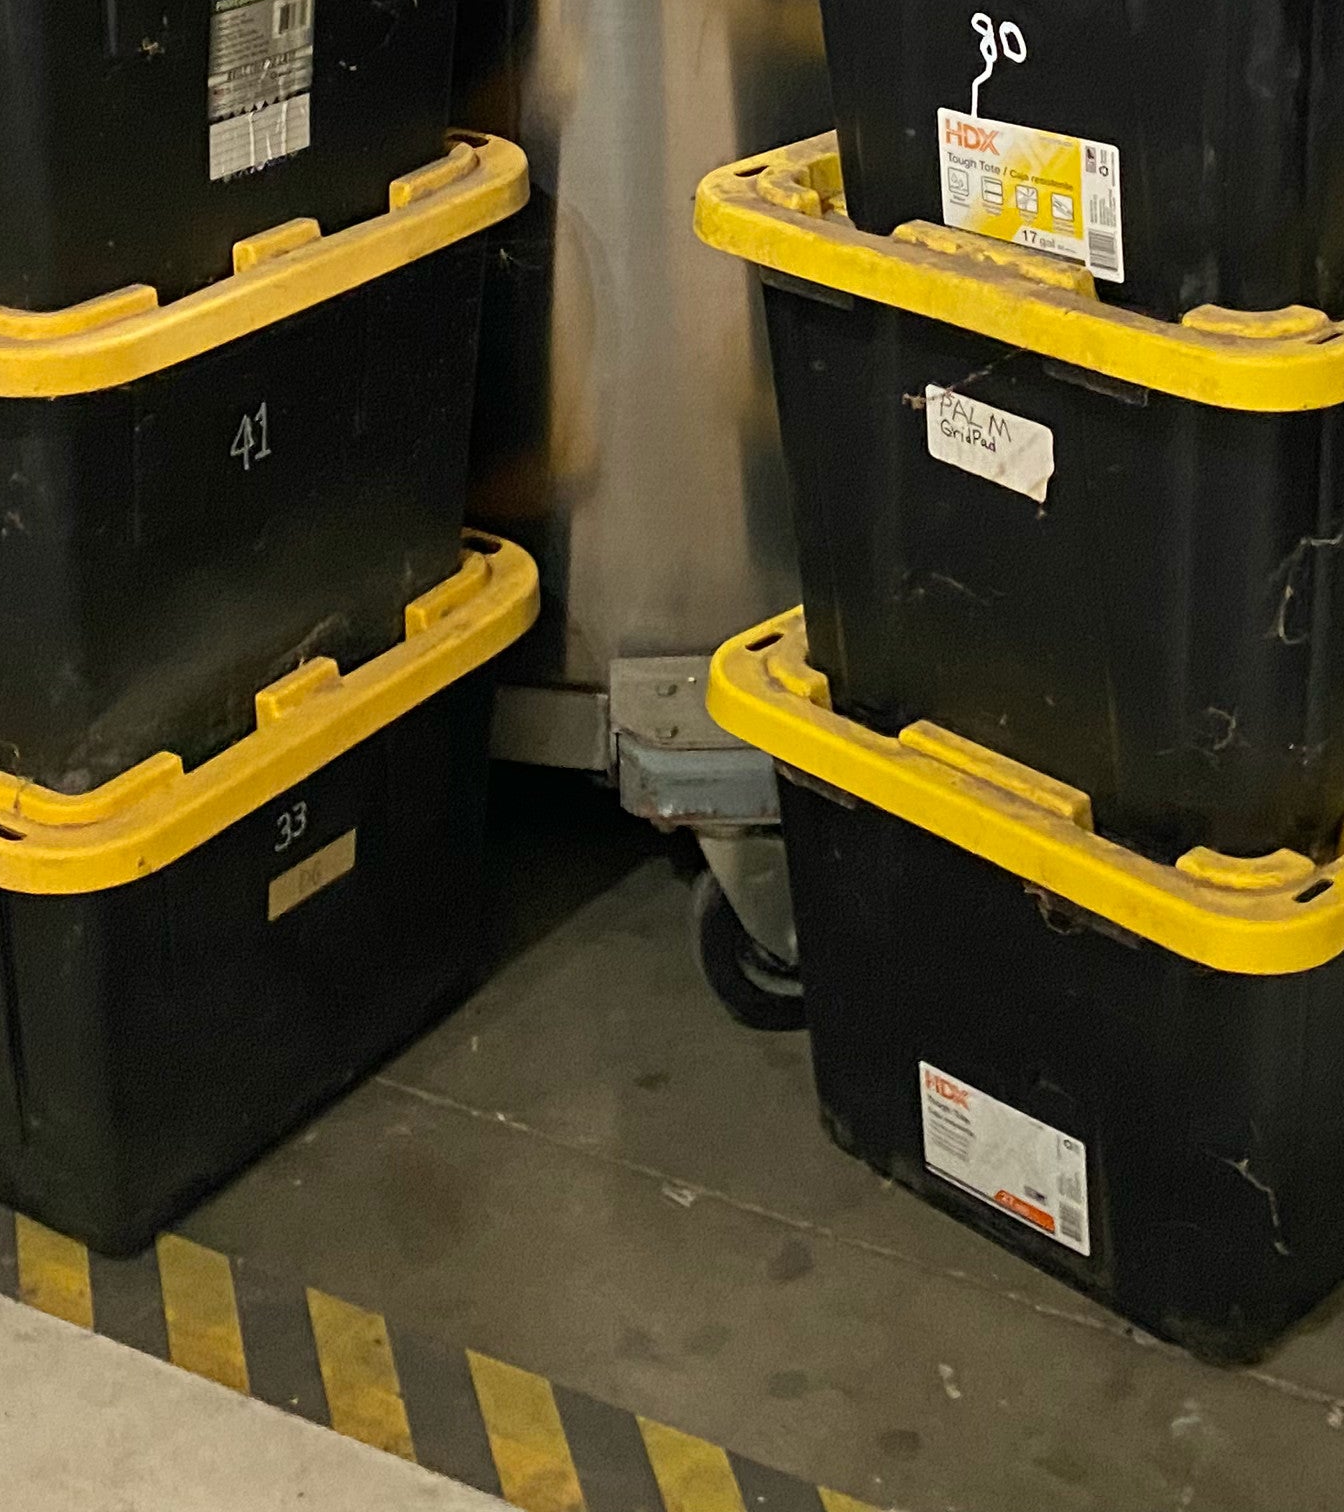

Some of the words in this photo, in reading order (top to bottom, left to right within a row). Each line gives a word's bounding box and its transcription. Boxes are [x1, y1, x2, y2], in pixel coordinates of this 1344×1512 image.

[971, 12, 1028, 72] 80
[945, 118, 1000, 156] HDX
[947, 151, 977, 170] Tough
[978, 160, 1001, 176] Tote
[1009, 168, 1030, 182] Caja
[1022, 229, 1038, 244] 17
[230, 401, 272, 470] 41
[274, 800, 308, 852] 33
[924, 1067, 971, 1113] HDX
